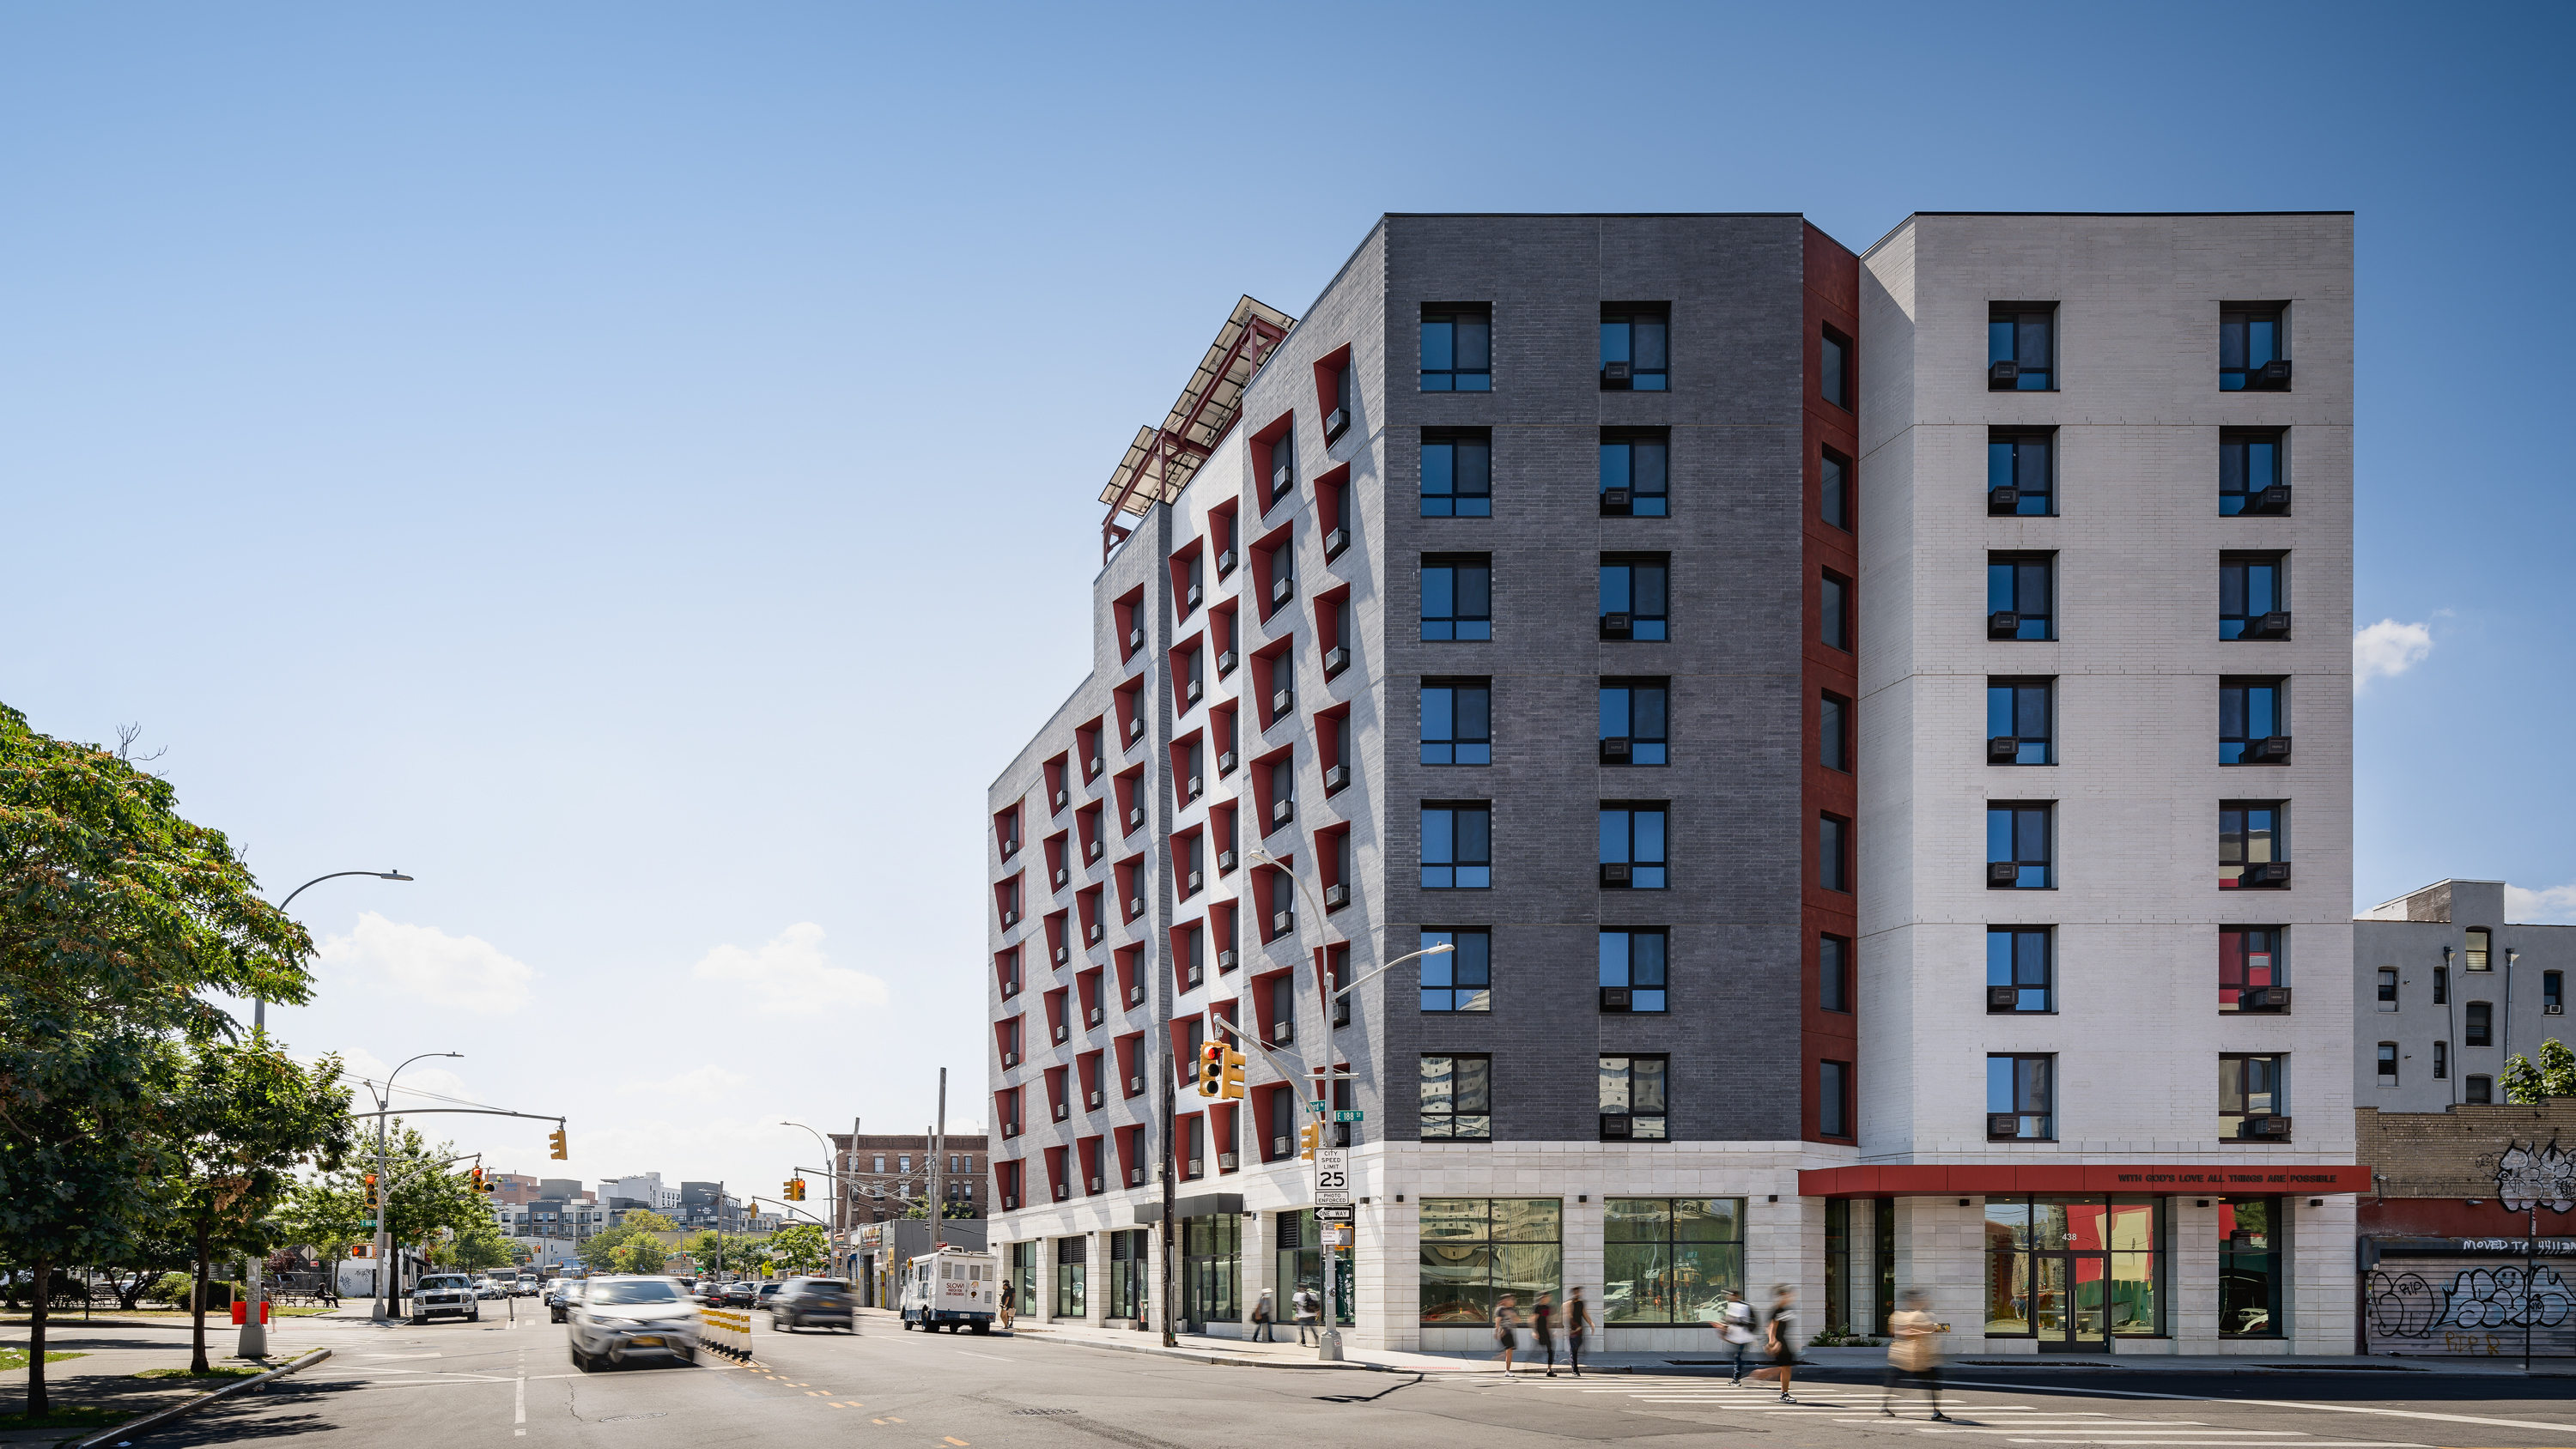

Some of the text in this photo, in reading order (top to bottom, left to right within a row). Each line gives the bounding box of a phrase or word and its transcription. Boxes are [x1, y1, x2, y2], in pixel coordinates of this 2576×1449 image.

[1337, 1112, 1341, 1121] E
[1343, 1112, 1354, 1121] 188
[1320, 1172, 1345, 1187] 25
[2228, 1174, 2263, 1183] THINGS
[2267, 1174, 2287, 1183] ARE
[2290, 1174, 2337, 1183] POSSIBLE
[2463, 1240, 2508, 1250] MOVED
[2399, 1282, 2422, 1295] RIP
[2445, 1331, 2478, 1355] RIP
